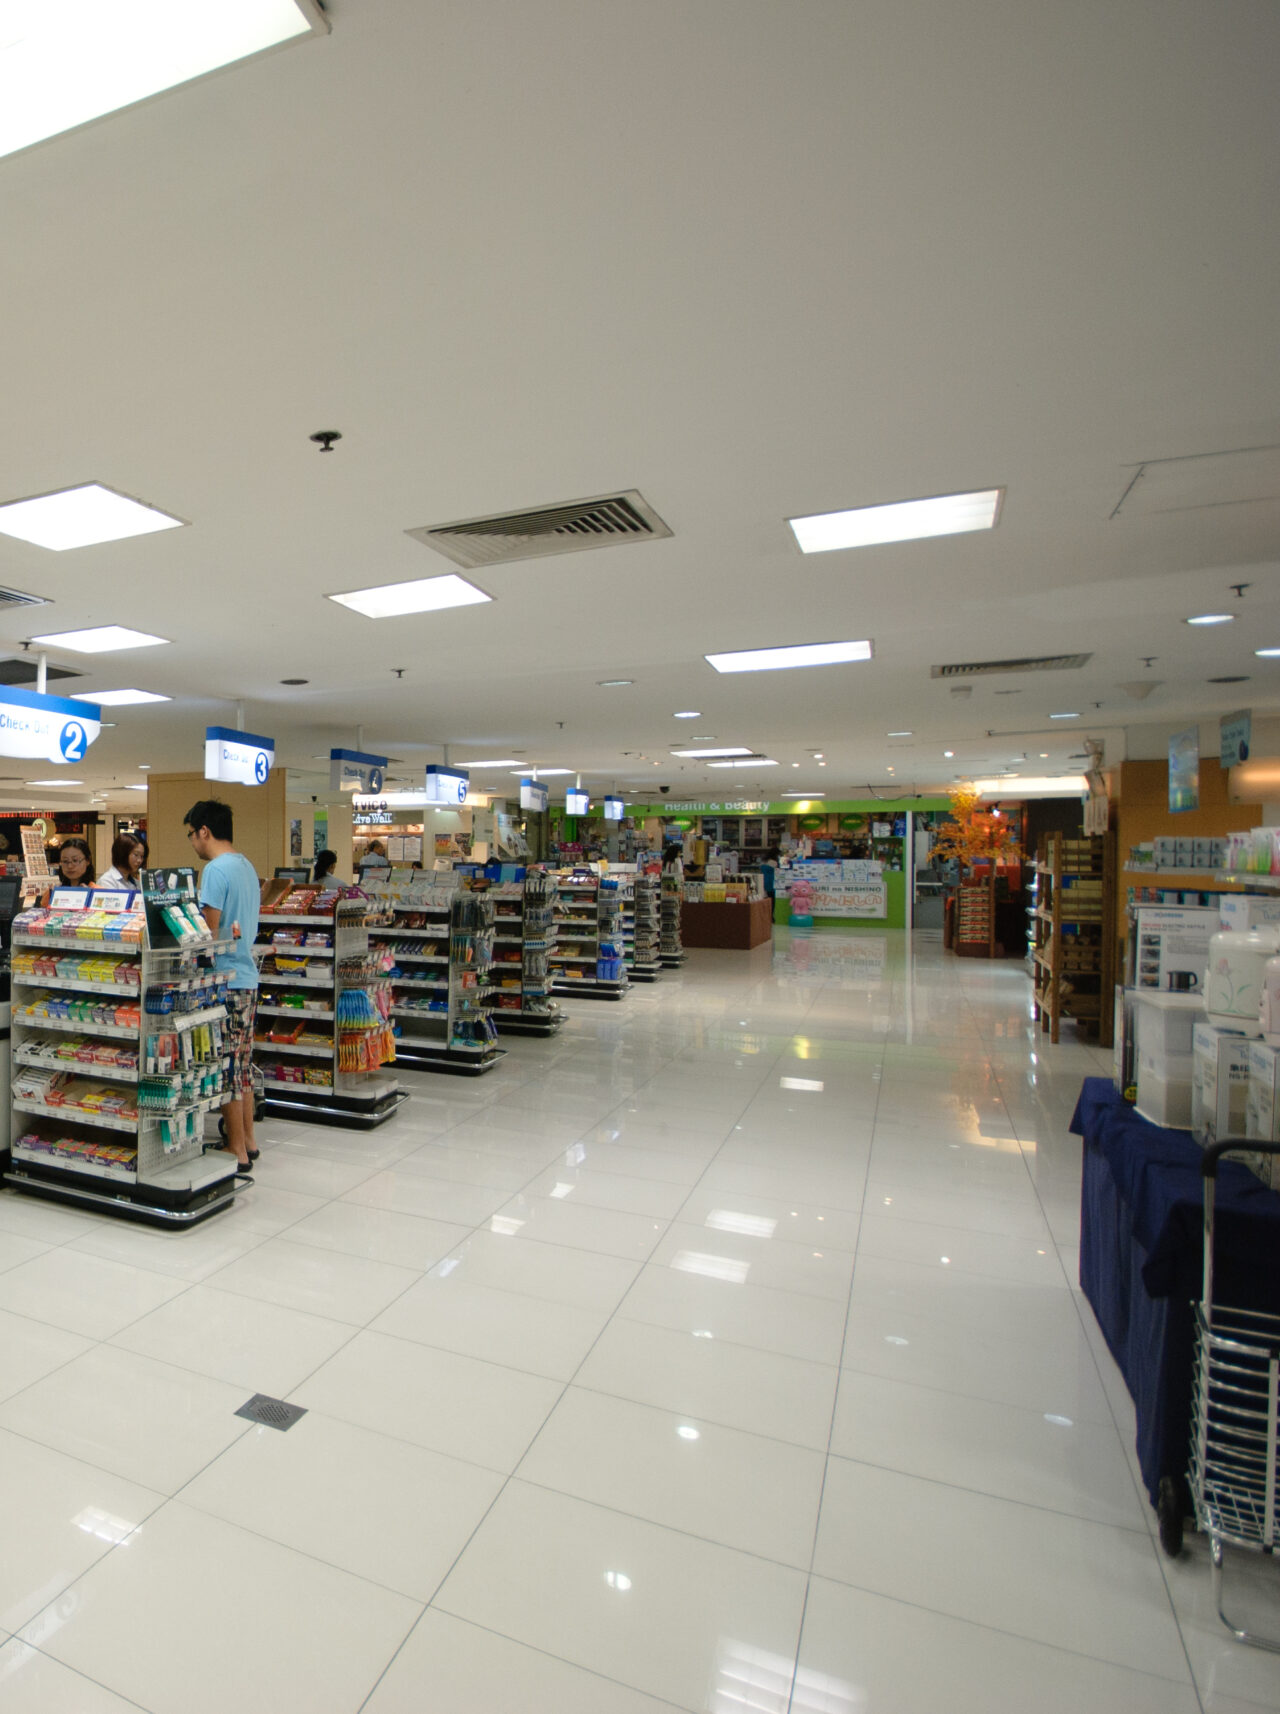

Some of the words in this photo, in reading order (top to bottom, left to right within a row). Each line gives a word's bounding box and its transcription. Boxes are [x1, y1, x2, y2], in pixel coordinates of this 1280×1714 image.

[64, 721, 83, 760] 2
[256, 754, 267, 782] 3
[458, 781, 467, 803] 5
